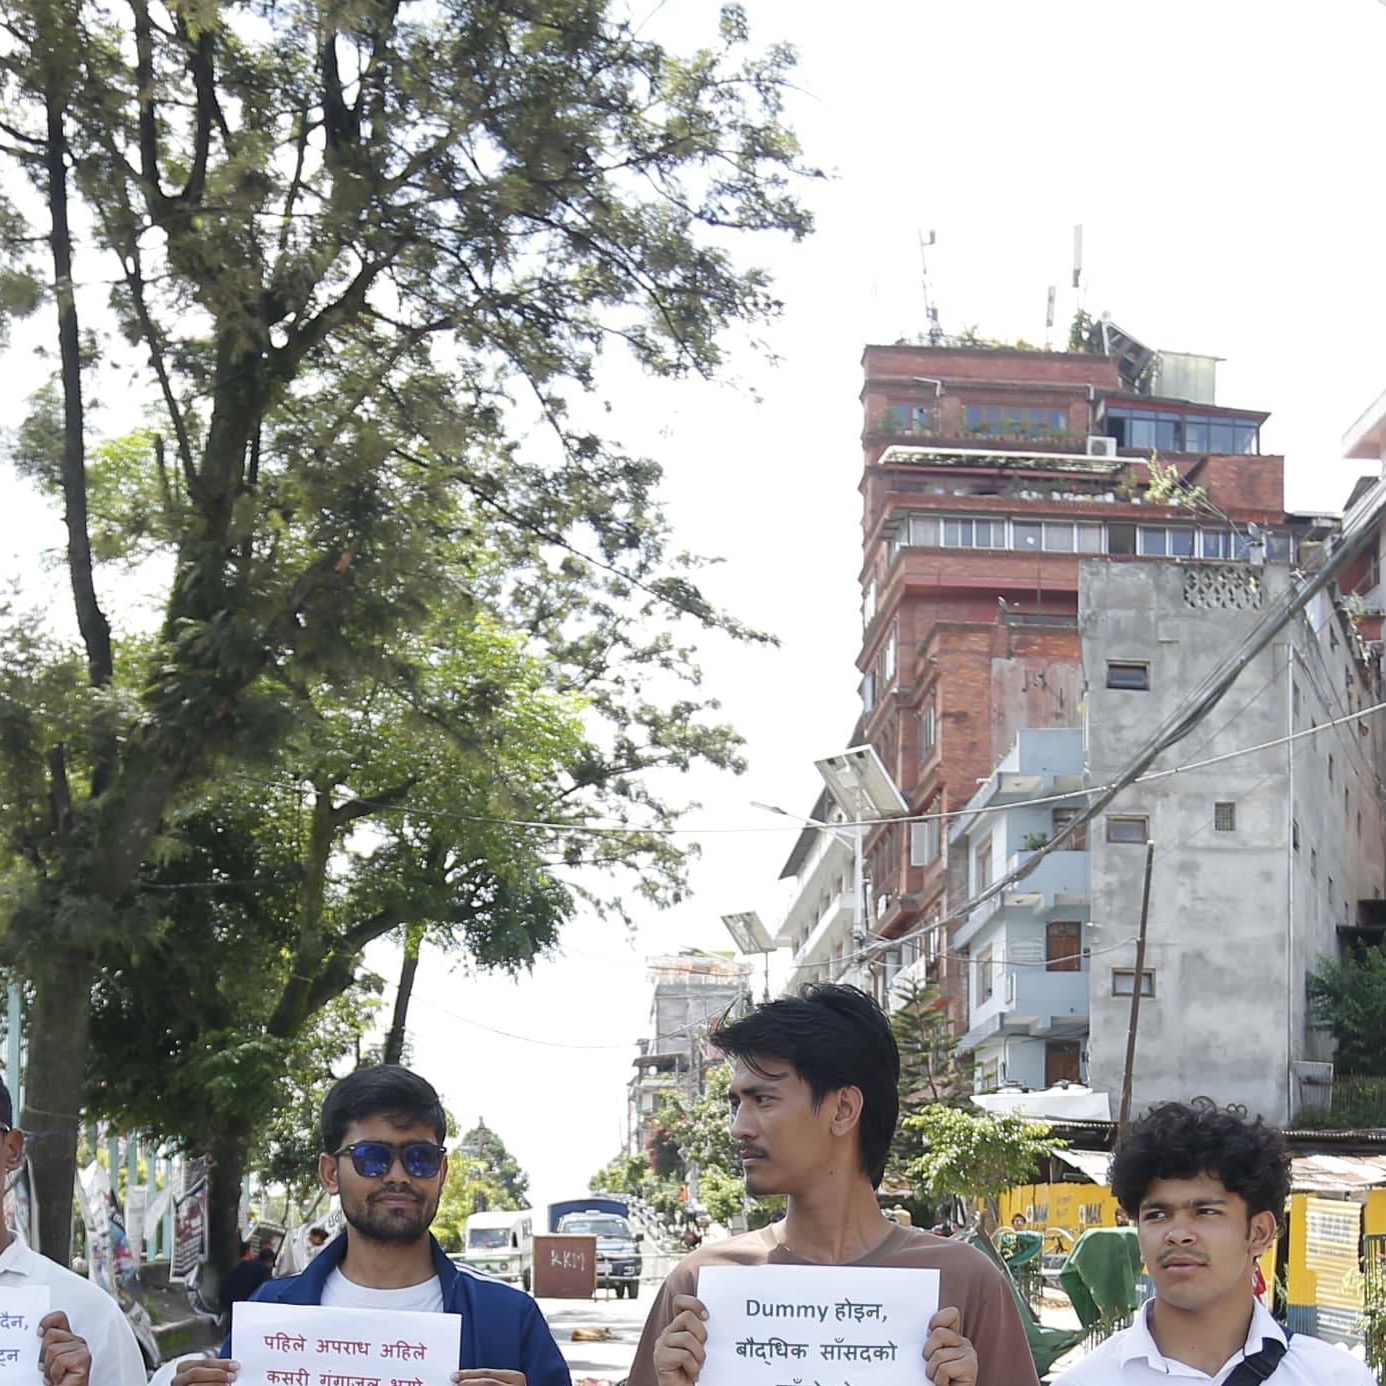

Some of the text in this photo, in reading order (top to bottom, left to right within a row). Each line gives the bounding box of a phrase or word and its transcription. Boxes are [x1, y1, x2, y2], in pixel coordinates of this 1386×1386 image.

[746, 1298, 887, 1323] Dummy होइन,
[264, 1332, 427, 1361] पहिले अपराध अहिले
[820, 1338, 898, 1362] साँसदको
[266, 1368, 310, 1386] कसरी
